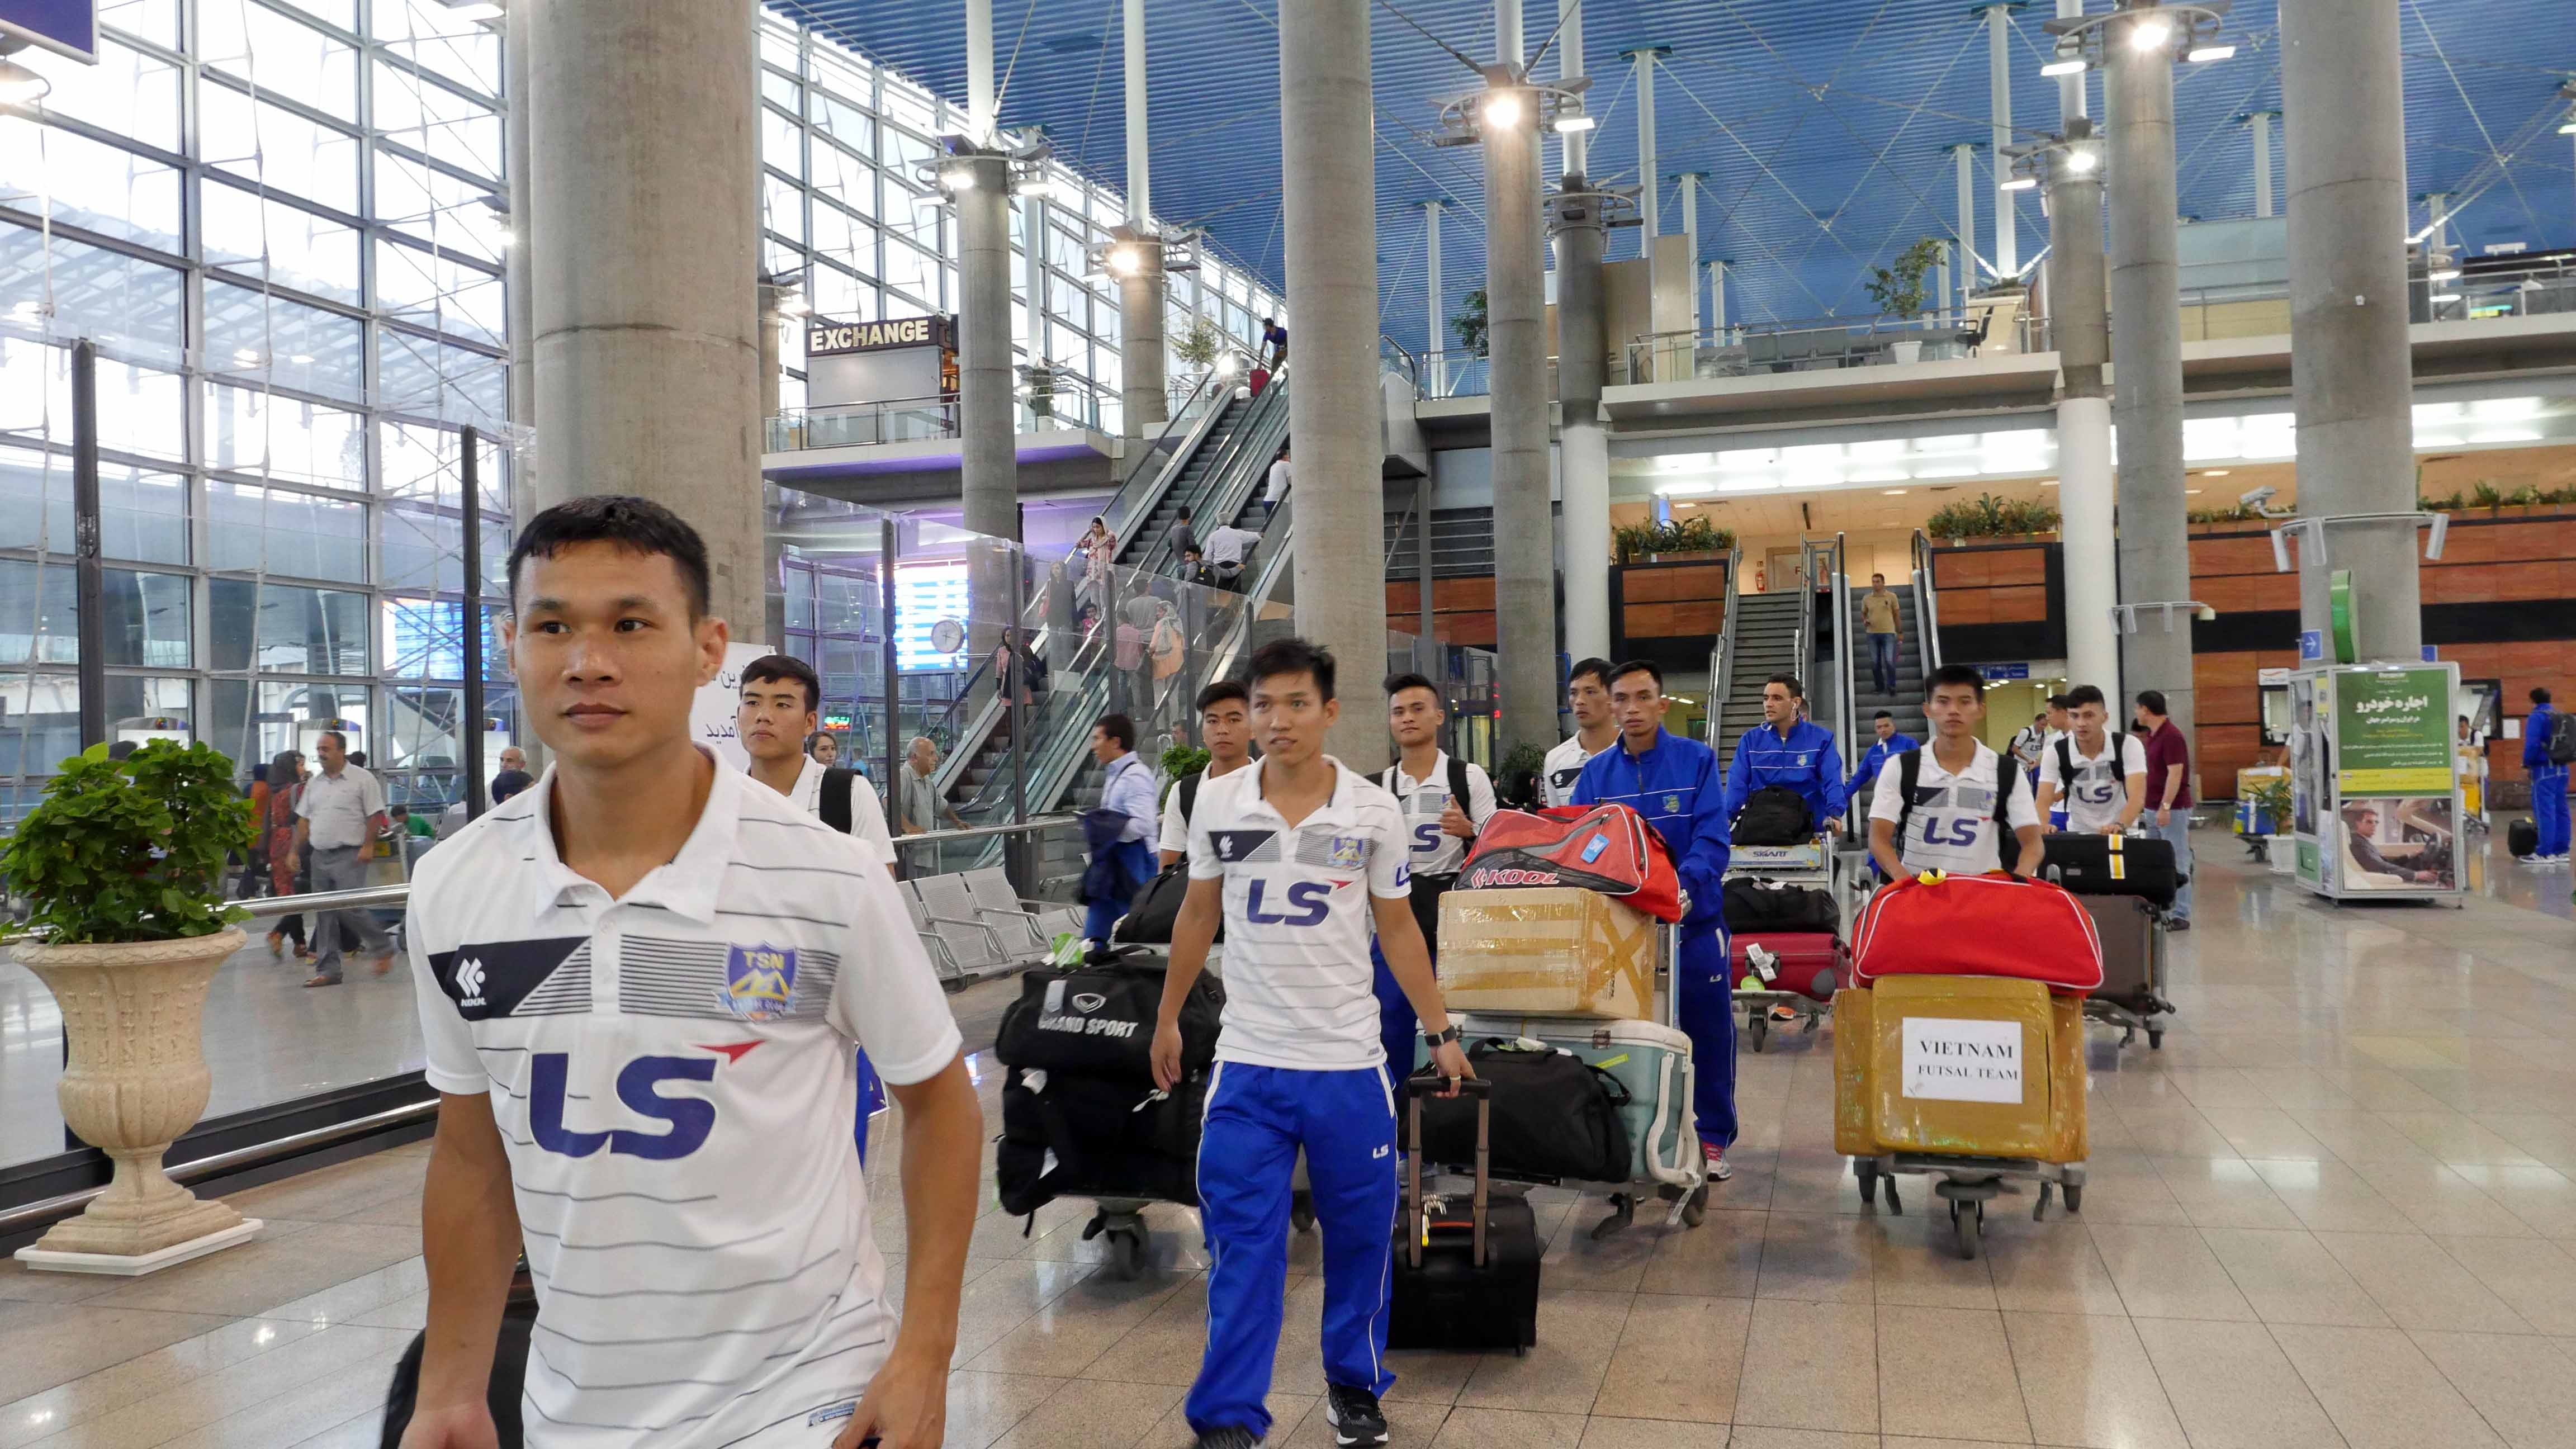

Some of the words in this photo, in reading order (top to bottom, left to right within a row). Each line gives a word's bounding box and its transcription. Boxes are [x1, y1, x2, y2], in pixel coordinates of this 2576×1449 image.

[811, 320, 929, 352] EXCHANGE
[2355, 697, 2394, 713] خودرو
[2395, 695, 2428, 712] اجاره
[706, 716, 740, 745] آمدید
[2076, 785, 2113, 804] LS
[1408, 823, 1441, 852] S
[1924, 817, 1978, 847] LS
[1485, 869, 1560, 886] KOOL
[1246, 879, 1332, 927] LS
[742, 950, 785, 970] TSN
[460, 997, 487, 1007] KOOL
[1085, 1018, 1139, 1038] SPORT
[1920, 1040, 2013, 1058] VIETNAM
[1918, 1064, 1973, 1078] FUTSAL
[1976, 1067, 2018, 1080] TEAM
[529, 1052, 717, 1161] LS
[1372, 1144, 1389, 1159] LS
